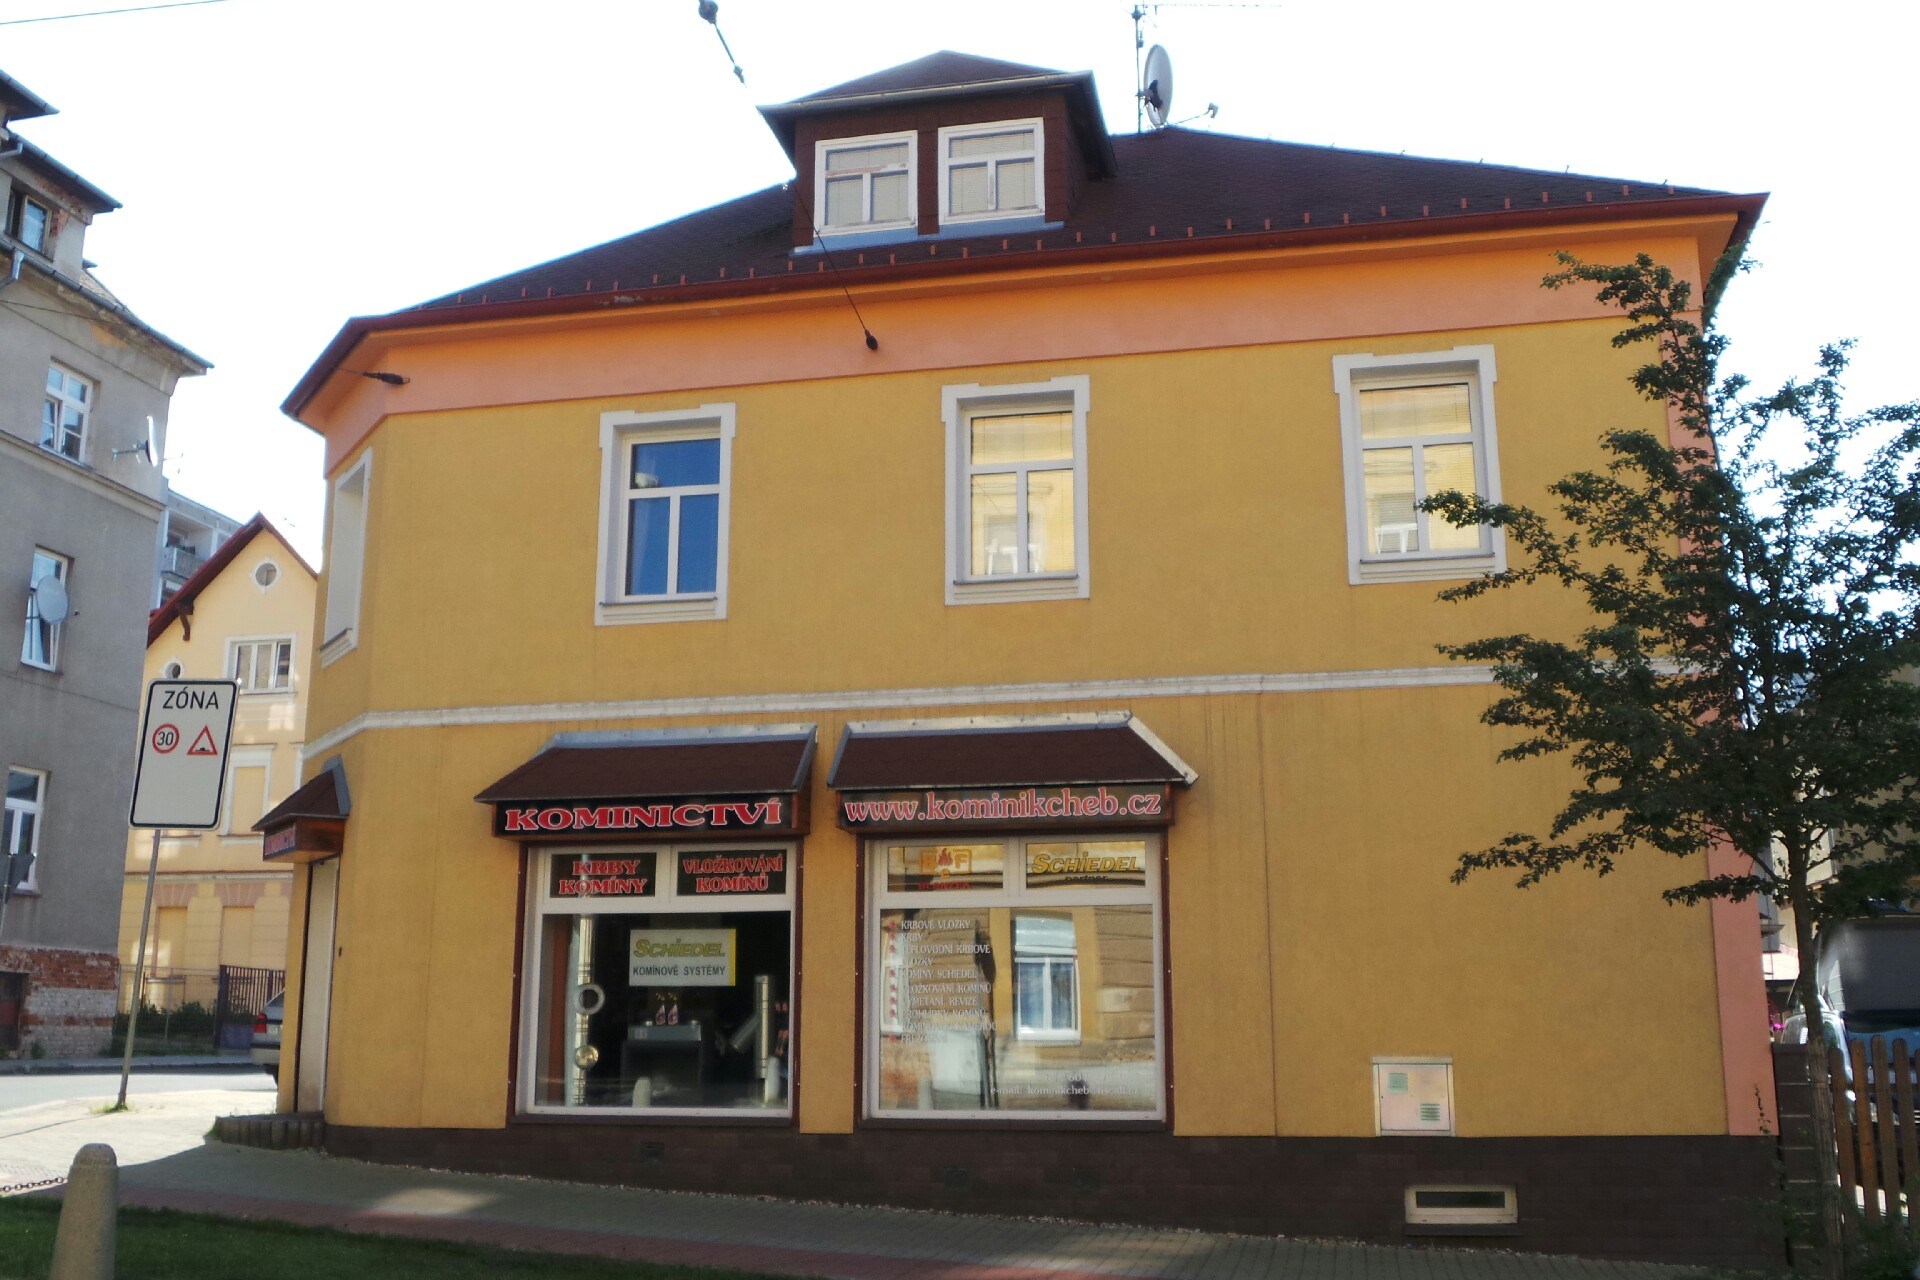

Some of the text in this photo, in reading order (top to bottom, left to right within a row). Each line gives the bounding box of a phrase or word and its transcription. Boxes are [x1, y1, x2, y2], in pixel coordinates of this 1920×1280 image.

[162, 686, 219, 710] ZÓNA
[156, 731, 174, 746] 30
[504, 797, 782, 831] KOMINICTVÍ
[844, 788, 1161, 822] www.kominikcheb.cz
[572, 859, 641, 876] KRBY
[682, 853, 784, 875] VLOŽKOVÁNÍ
[558, 876, 648, 895] KOMÍNY
[695, 872, 769, 893] KOMÍNŮ
[632, 964, 726, 976] KOMÍNOVÉ SYSTÉMY
